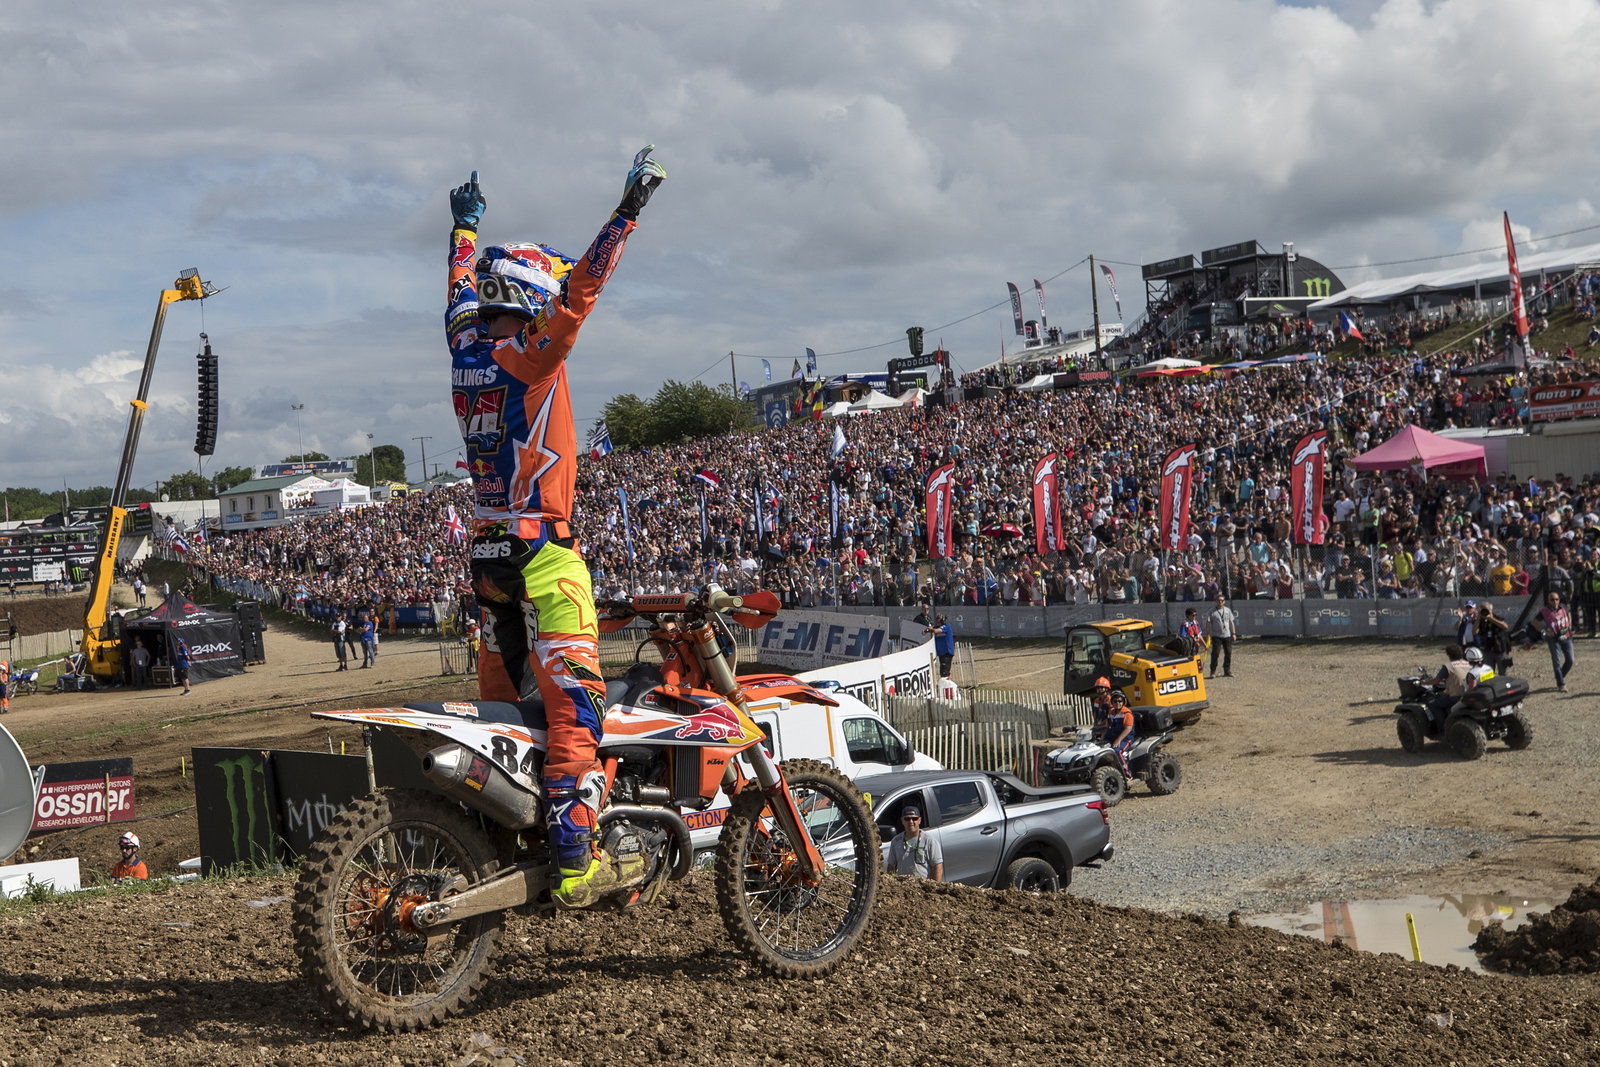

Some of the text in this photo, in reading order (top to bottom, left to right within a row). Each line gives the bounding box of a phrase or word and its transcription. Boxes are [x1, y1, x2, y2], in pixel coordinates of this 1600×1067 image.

[897, 356, 935, 369] PADDOCK
[1535, 390, 1567, 401] MOTO
[1570, 389, 1582, 398] 17
[1303, 460, 1315, 543] alpinestars
[1043, 480, 1056, 551] alpinestars
[1170, 472, 1182, 549] alpinestars
[936, 489, 947, 556] alpinestars
[107, 517, 120, 559] MAISSANT
[638, 597, 682, 605] RENTHAL
[191, 641, 233, 656] 24MX
[1159, 680, 1187, 695] JCB
[53, 785, 67, 793] HIGH
[67, 782, 106, 792] PERFORMANC
[37, 819, 67, 828] RESEARCH
[72, 815, 106, 825] DEVELOPME
[682, 811, 722, 829] CTION
